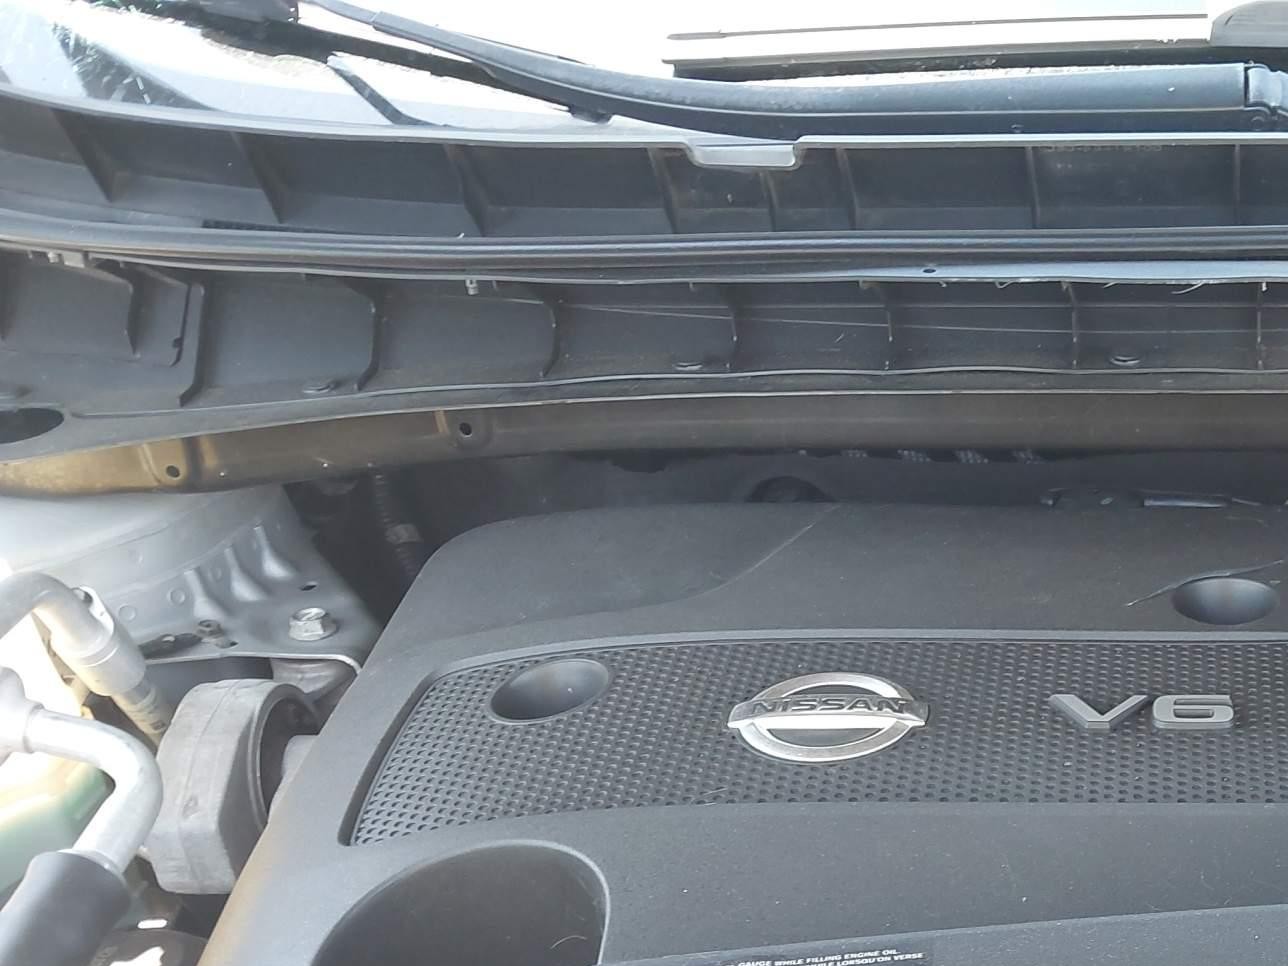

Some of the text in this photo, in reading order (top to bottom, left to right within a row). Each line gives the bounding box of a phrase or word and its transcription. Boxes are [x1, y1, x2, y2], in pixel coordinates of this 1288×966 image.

[750, 697, 909, 715] NISSAN
[1049, 693, 1235, 730] V6
[774, 958, 804, 966] WHILE
[806, 954, 842, 964] FILLING
[843, 950, 881, 960] ENGINE
[836, 956, 892, 966] LORSQU'ON
[892, 952, 924, 961] VERSE
